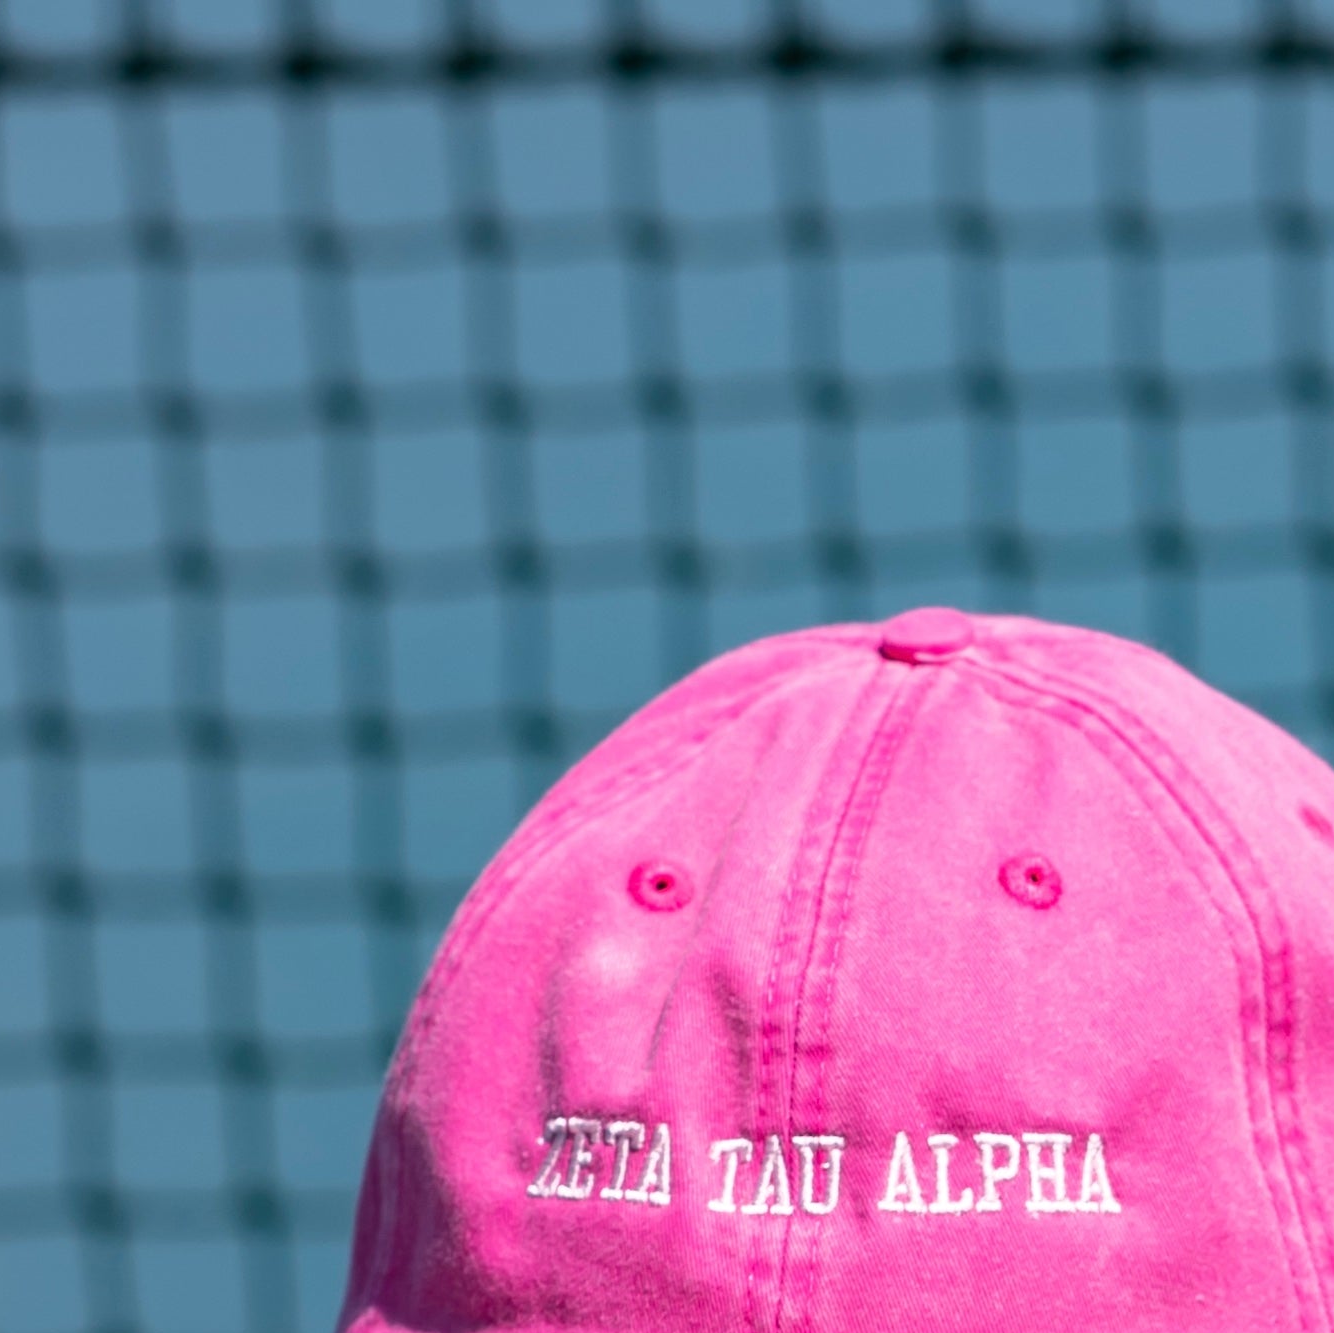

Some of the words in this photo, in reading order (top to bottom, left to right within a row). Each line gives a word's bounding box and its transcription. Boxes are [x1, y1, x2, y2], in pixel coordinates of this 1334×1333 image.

[526, 1116, 672, 1206] ZETA
[707, 1134, 845, 1215] TAU
[876, 1131, 1122, 1217] ALPHA
